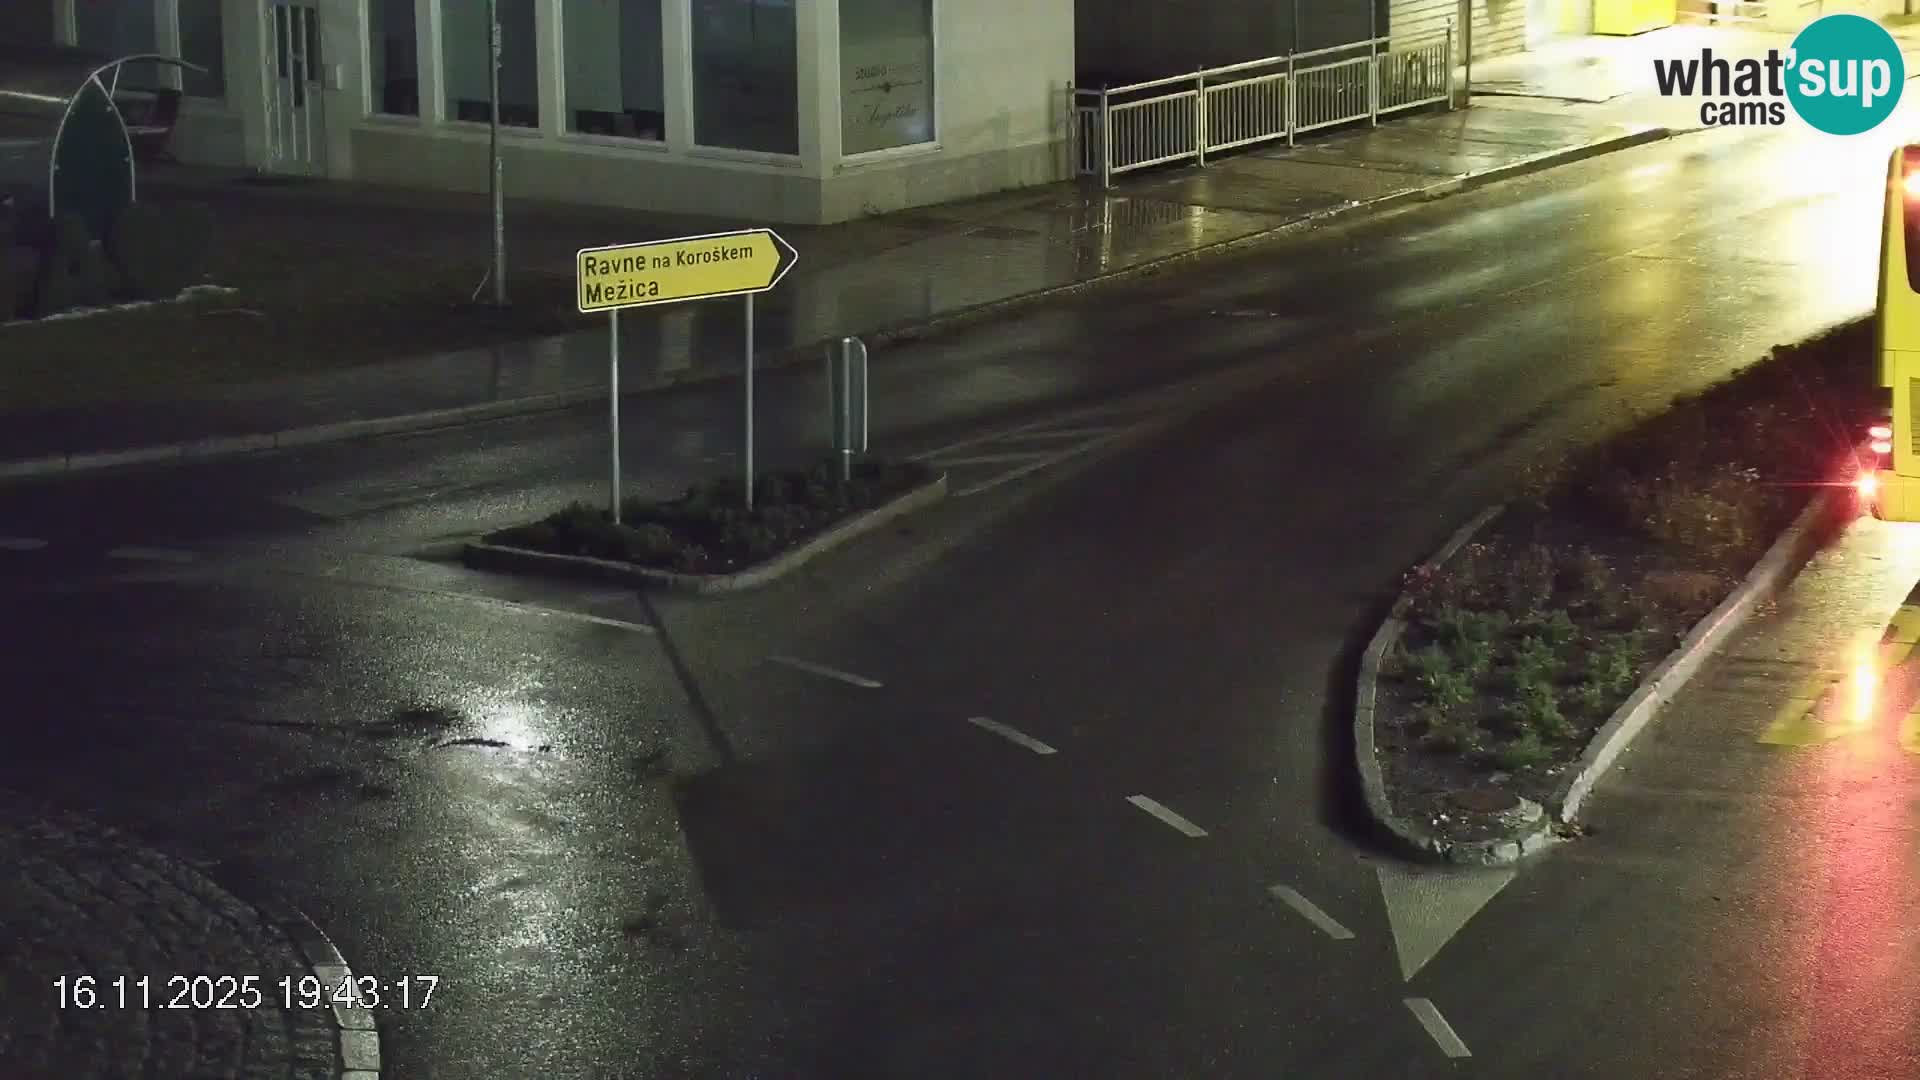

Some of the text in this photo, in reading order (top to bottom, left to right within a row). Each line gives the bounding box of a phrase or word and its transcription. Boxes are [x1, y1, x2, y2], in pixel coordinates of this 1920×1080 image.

[585, 246, 753, 276] Ravne na Koroškem
[586, 280, 659, 304] Mežica
